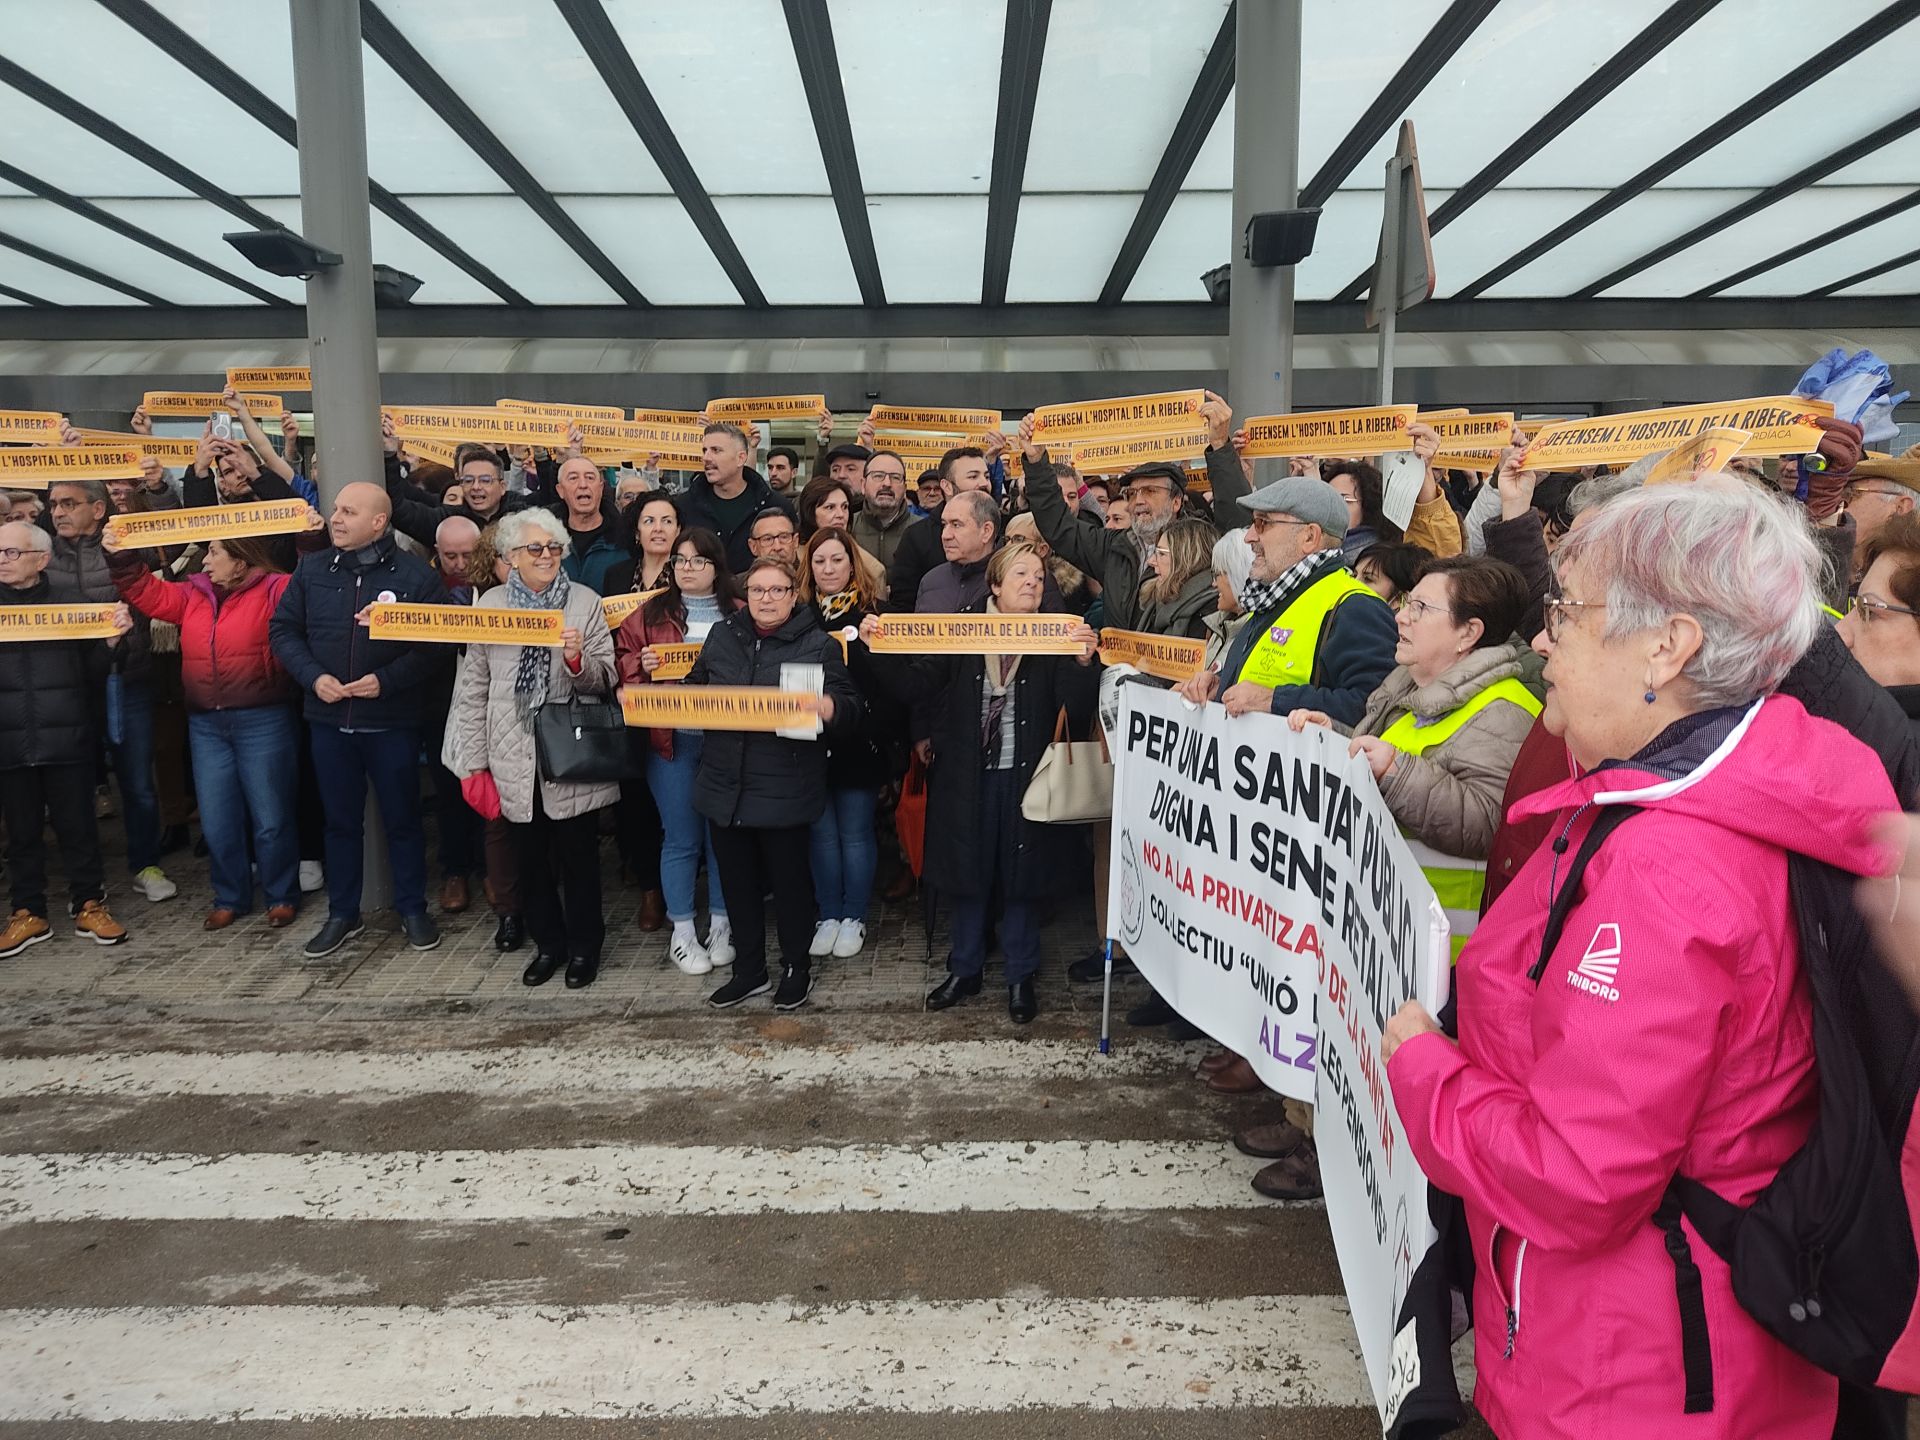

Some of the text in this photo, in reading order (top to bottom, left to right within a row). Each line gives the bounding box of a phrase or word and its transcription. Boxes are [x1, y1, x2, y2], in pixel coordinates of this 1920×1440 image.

[234, 372, 269, 382] DEFENSEM
[270, 372, 307, 381] L'HOSPITAL
[151, 397, 186, 406] DEFENSEM
[188, 398, 228, 407] L'HOSPITA
[249, 399, 273, 408] RIBERA
[712, 403, 741, 412] DEFENSEM
[742, 402, 775, 411] L'HOSPITAL
[776, 401, 784, 410] DE
[785, 401, 794, 409] LA
[794, 400, 815, 409] RIBERA
[538, 407, 573, 417] L'HOSPITAL
[584, 410, 592, 418] LA
[593, 411, 616, 420] RIBERA
[642, 414, 698, 424] DEFENSEM L'HOSPIT
[876, 411, 992, 425] DEFENSEM L'HOSPITAL DE LA RIBERA
[1043, 401, 1190, 428] DEFENSEM L'HOSPITAL DE LA RIBERA
[0, 418, 48, 430] LA RIBERA
[404, 414, 450, 426] DEFENSEM
[452, 416, 501, 431] L'HOSPITAL
[504, 419, 514, 431] DE
[516, 420, 527, 432] LA
[529, 421, 559, 434] RIBERA
[1250, 416, 1398, 441] DEFENSEM L'HOSPITAL DE LA RIBERA
[1433, 421, 1499, 437] DE LA RIBERA
[1546, 427, 1616, 446] DEFENSEM
[1614, 418, 1694, 442] L'HOSPITAL
[1696, 415, 1720, 435] DE
[1740, 408, 1803, 430] RIBERA
[578, 424, 616, 436] DEFENSEM
[617, 428, 658, 440] L'HOSPITAL
[660, 431, 670, 441] DE
[671, 432, 681, 442] LA
[683, 432, 704, 443] RIBER
[142, 444, 194, 456] HOSPITAL DE
[873, 438, 892, 446] ENSEM
[892, 438, 922, 448] L'HOSPITAL
[923, 439, 931, 448] DE
[931, 440, 939, 448] LA
[1083, 445, 1120, 458] DEFENSEM
[1121, 440, 1163, 454] L'HOSPITAL
[1164, 438, 1174, 449] DE
[1176, 437, 1185, 447] LA
[1187, 433, 1209, 446] RIBER
[1539, 448, 1552, 456] NO
[1553, 448, 1563, 456] AL
[1565, 445, 1617, 455] TANCAMENT
[1617, 444, 1630, 452] DE
[1644, 440, 1676, 449] UNITAT
[1749, 429, 1792, 441] RDÍACA
[2, 453, 129, 468] L'HOSPITAL DE LA RIBERA
[1463, 449, 1493, 460] RIBERA
[126, 518, 176, 534] DEFENSEM
[178, 513, 232, 529] L'HOSPITAL
[235, 512, 246, 523] DE
[249, 510, 261, 522] LA
[263, 507, 297, 520] RIBERA
[0, 611, 105, 626] PITAL DE LA RIBERA
[383, 610, 431, 625] DEFENSEM
[433, 613, 486, 628] L'HOSPITAL
[489, 616, 501, 628] DE
[503, 616, 513, 628] LA
[517, 617, 550, 630] RIBERA
[883, 622, 1068, 637] DEFENSEM L'HOSPITAL DE LA RIBERA
[664, 650, 700, 664] DEFENS
[1157, 645, 1164, 660] DE
[1165, 646, 1172, 661] LA
[1173, 647, 1196, 665] RIBERA
[1127, 710, 1418, 1003] PER UNA SANTAT PÚBLICA
[1149, 779, 1219, 854] DIGNA
[1230, 813, 1238, 862] I
[1250, 822, 1337, 929] SENE
[1341, 880, 1397, 1036] RETALL
[1566, 969, 1620, 1002] TRIBORD
[1150, 893, 1234, 972] COL·LECTIU
[1240, 952, 1299, 1015] “UNIÓ
[1320, 1029, 1342, 1096] LES
[1143, 839, 1395, 1179] NO A LA PRIVATIZAÓ DE LA SANITAT
